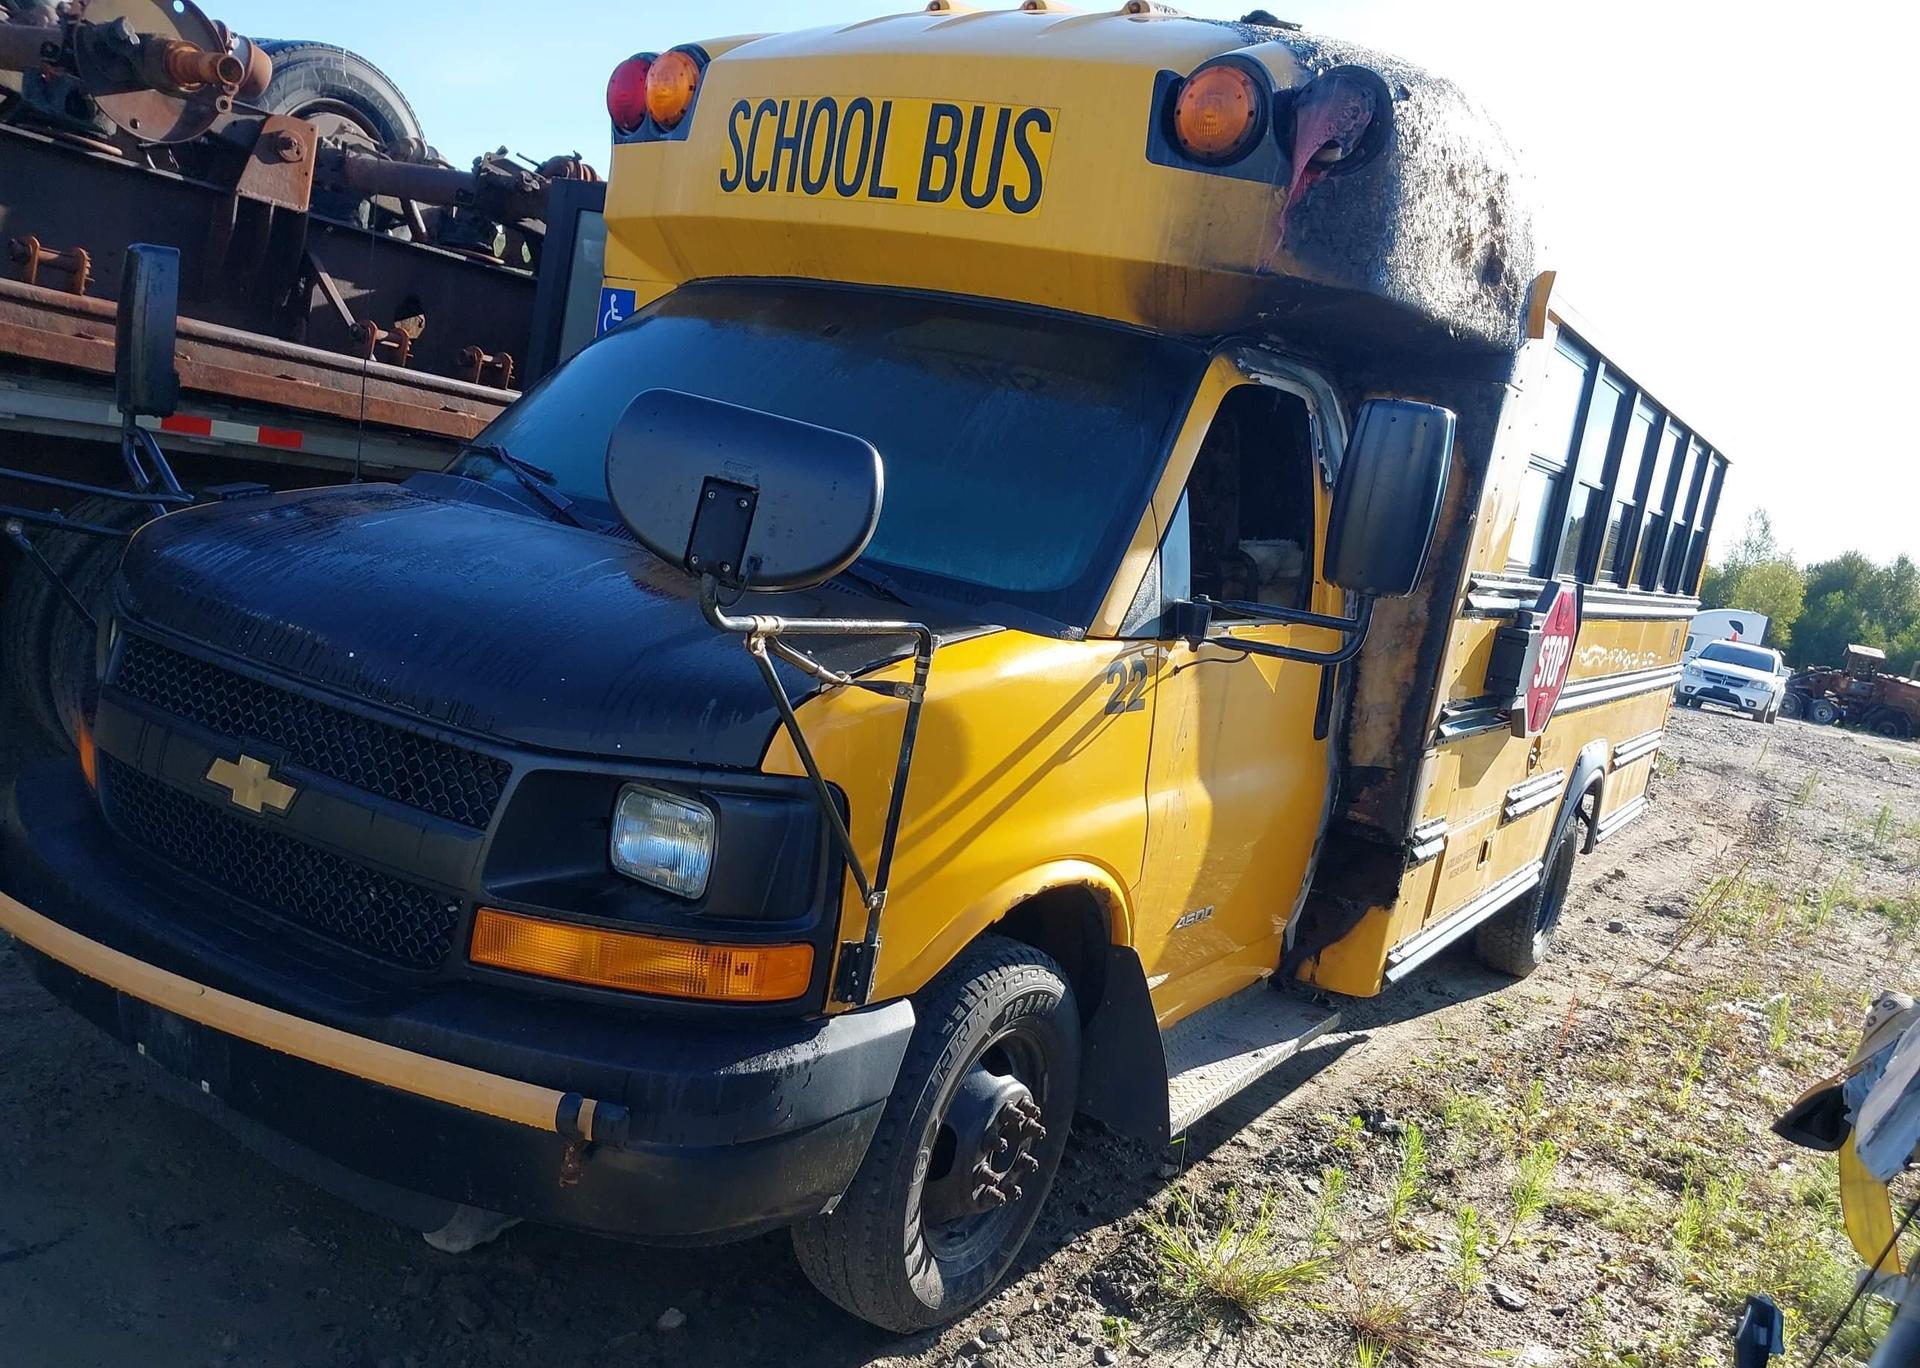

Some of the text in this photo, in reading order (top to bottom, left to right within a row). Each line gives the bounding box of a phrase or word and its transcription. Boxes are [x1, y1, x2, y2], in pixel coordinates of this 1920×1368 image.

[719, 97, 1052, 214] SCHOOL BUS
[1104, 659, 1148, 715] 22
[1534, 635, 1569, 688] STOP
